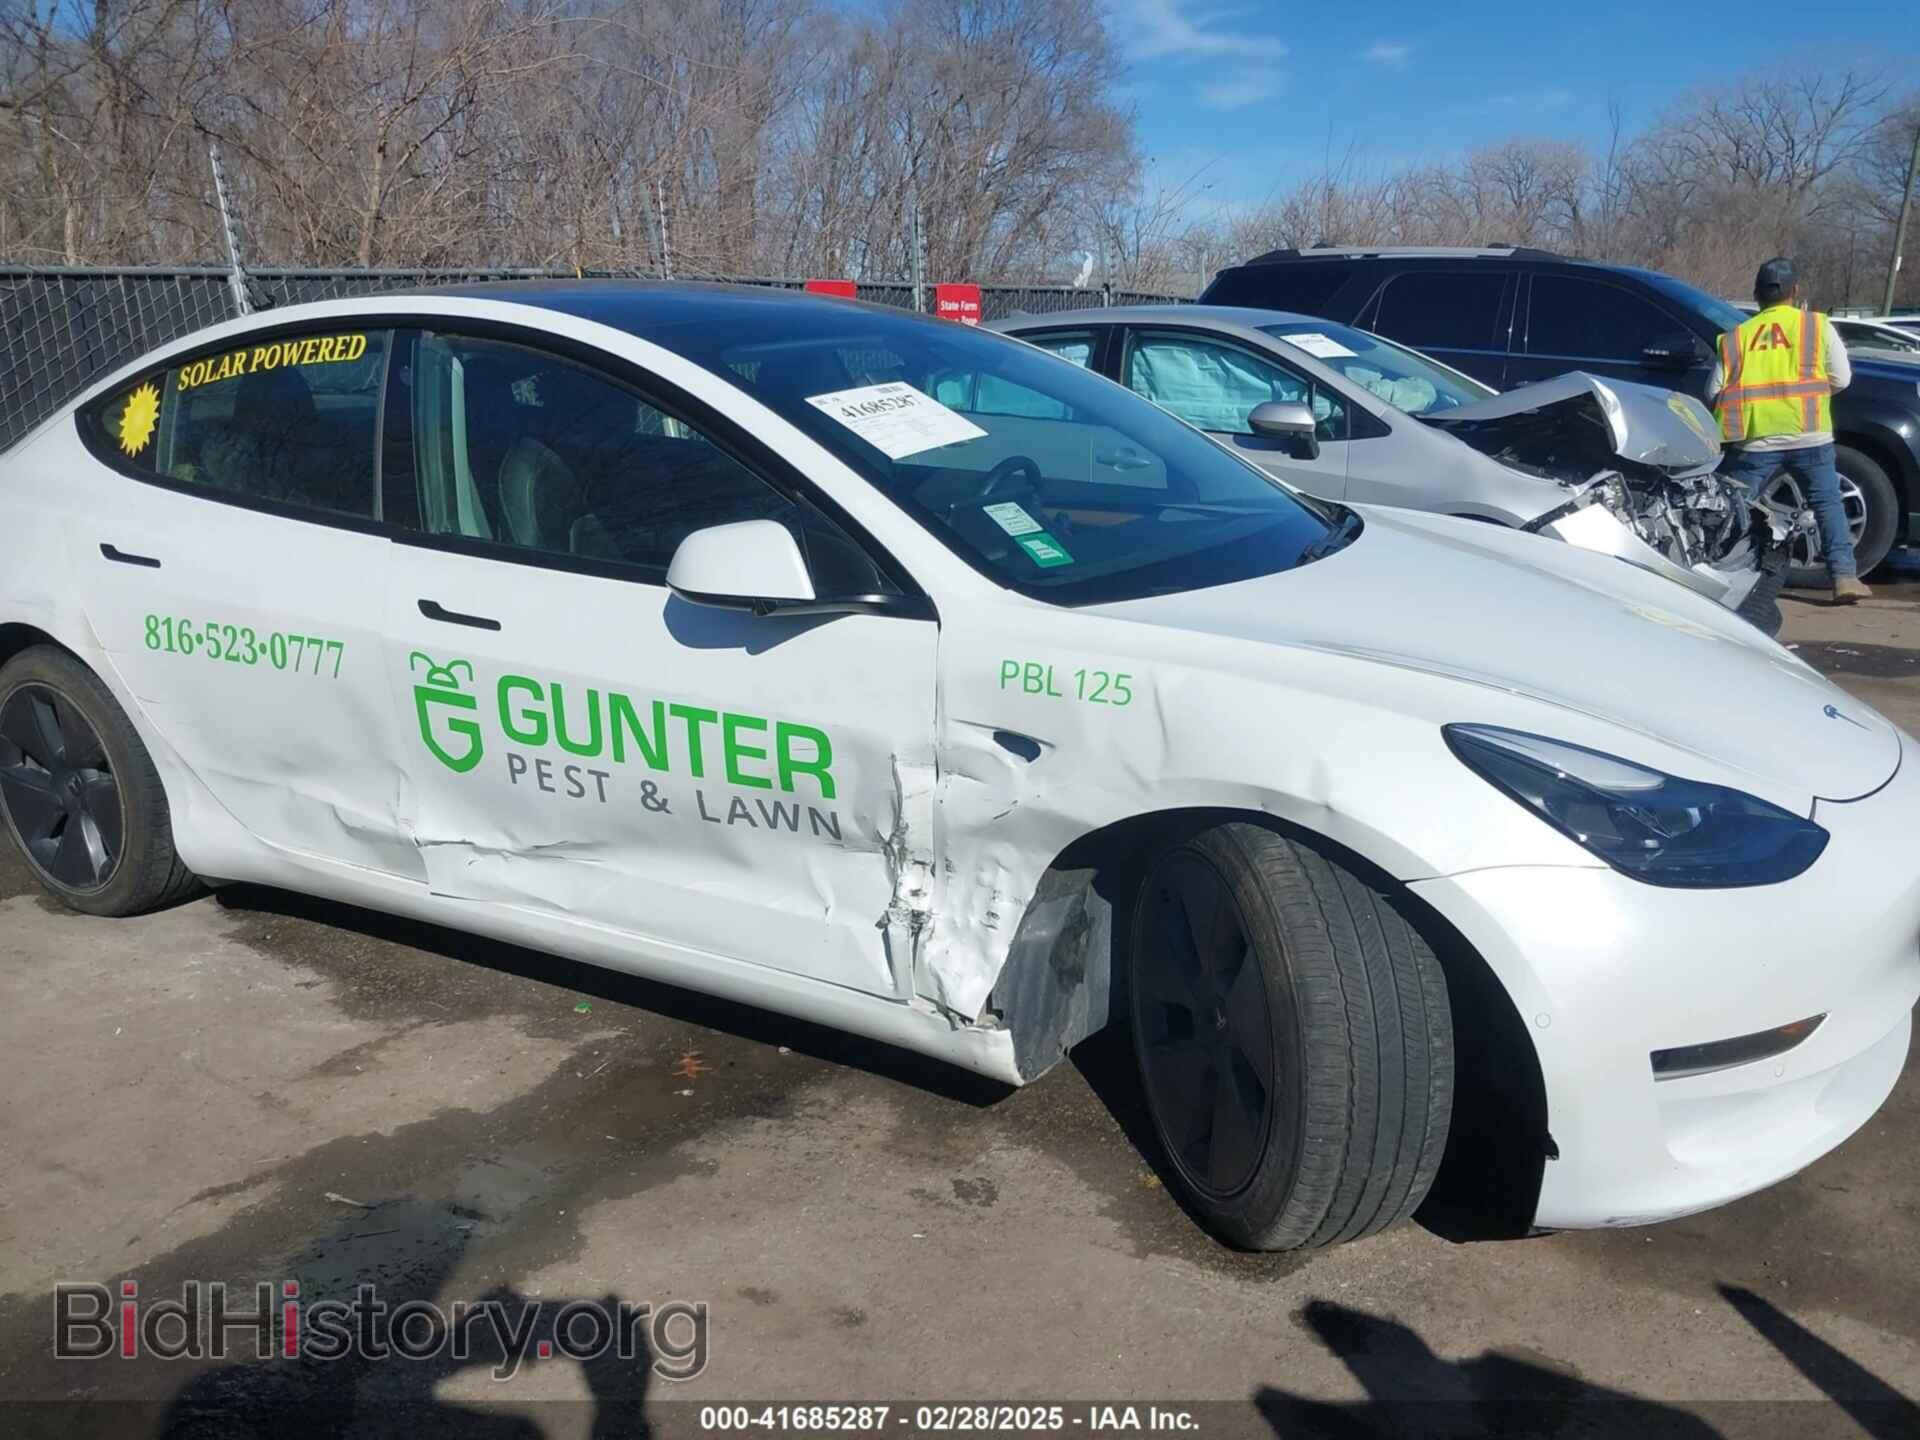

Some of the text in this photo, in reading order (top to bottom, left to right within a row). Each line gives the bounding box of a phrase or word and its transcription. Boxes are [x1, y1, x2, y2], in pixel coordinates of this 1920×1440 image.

[940, 300, 978, 311] State Farm
[178, 334, 367, 391] SOLAR POWERED
[840, 393, 919, 419] 41685287
[1000, 660, 1132, 706] PBL 125
[497, 674, 837, 799] GUNTER
[507, 752, 843, 840] PEST & LAWN
